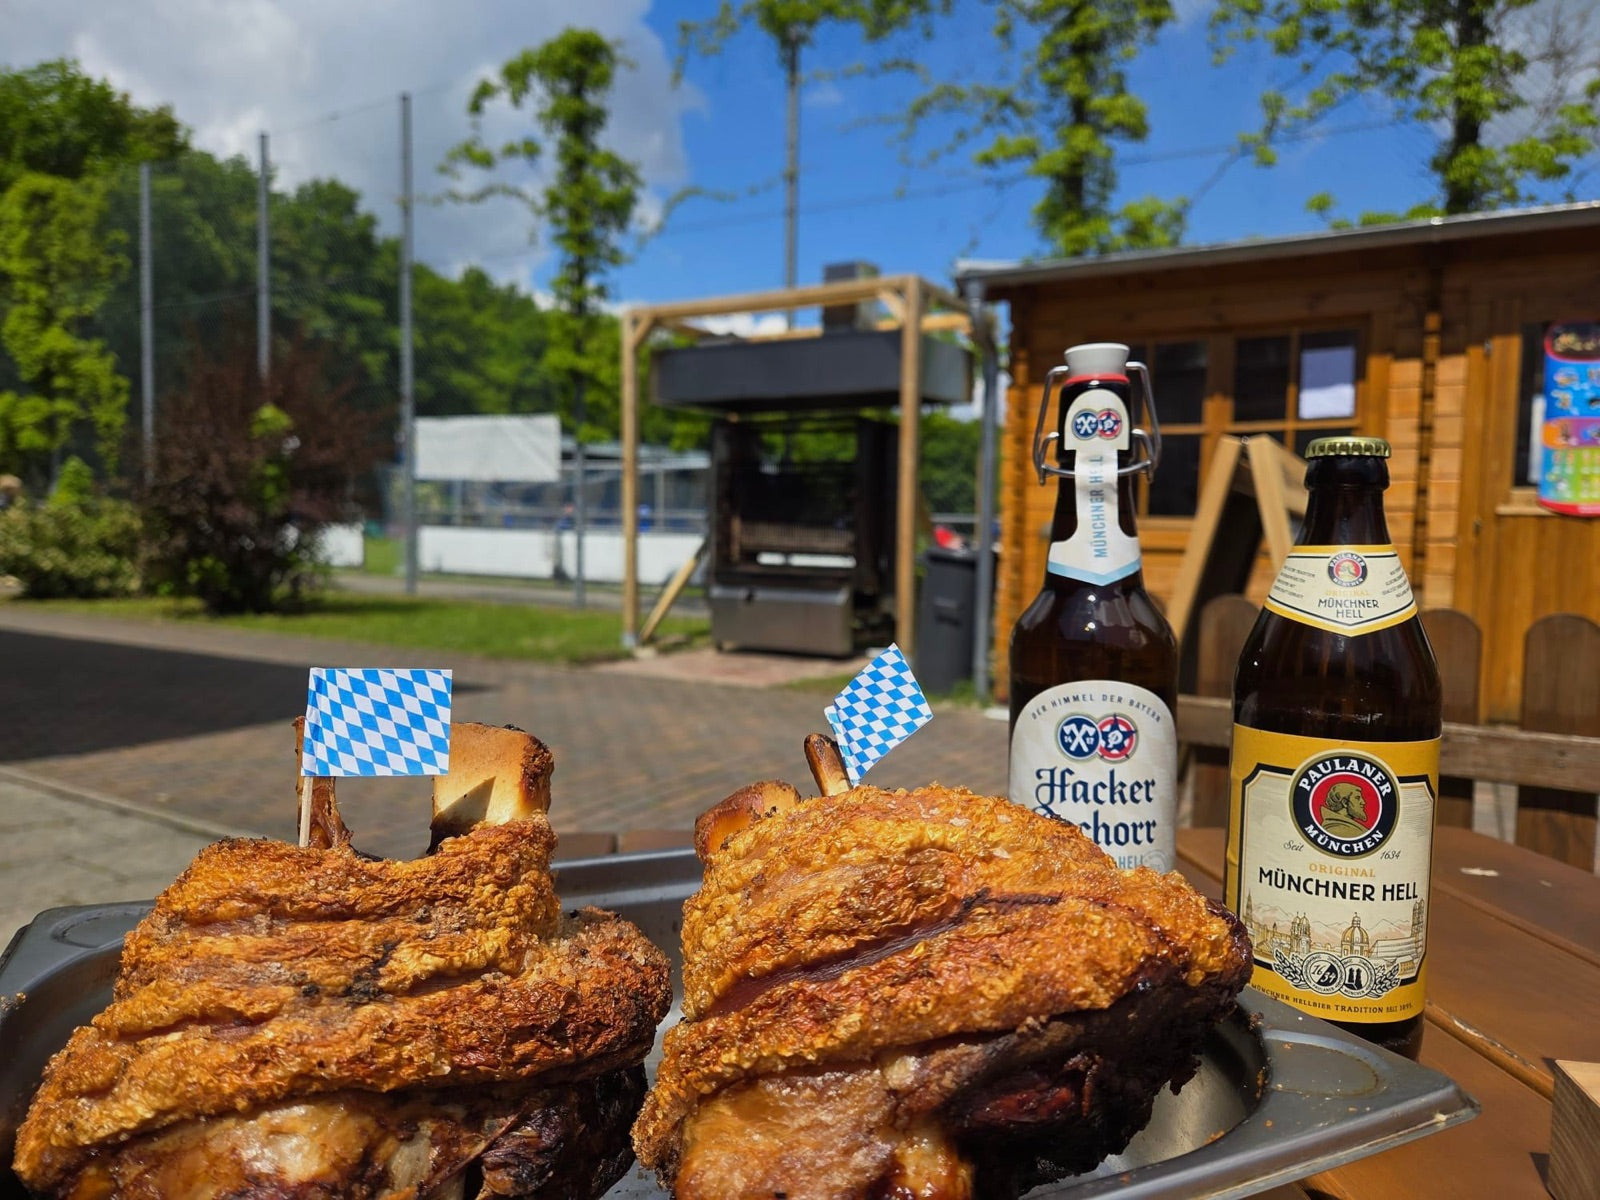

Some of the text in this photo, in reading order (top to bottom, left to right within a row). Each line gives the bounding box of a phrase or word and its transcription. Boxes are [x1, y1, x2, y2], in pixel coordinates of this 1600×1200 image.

[1089, 489, 1108, 558] MÜNCHNER
[1317, 597, 1380, 608] MÜNCHNER
[1336, 609, 1364, 619] HELL
[1031, 694, 1161, 723] DER HIMMEL DER BAYERN
[1035, 766, 1156, 806] Hacker
[1299, 758, 1393, 797] PAULANER
[1283, 840, 1401, 861] Seit 1634
[1304, 824, 1384, 854] MÜNCHEN
[1259, 867, 1418, 902] MÜNCHNER HELL
[1309, 863, 1376, 878] ORIGINAL
[1251, 983, 1290, 1001] MÜNCHNER
[1293, 997, 1331, 1010] HELLBIER
[1334, 1004, 1383, 1014] TRADITION
